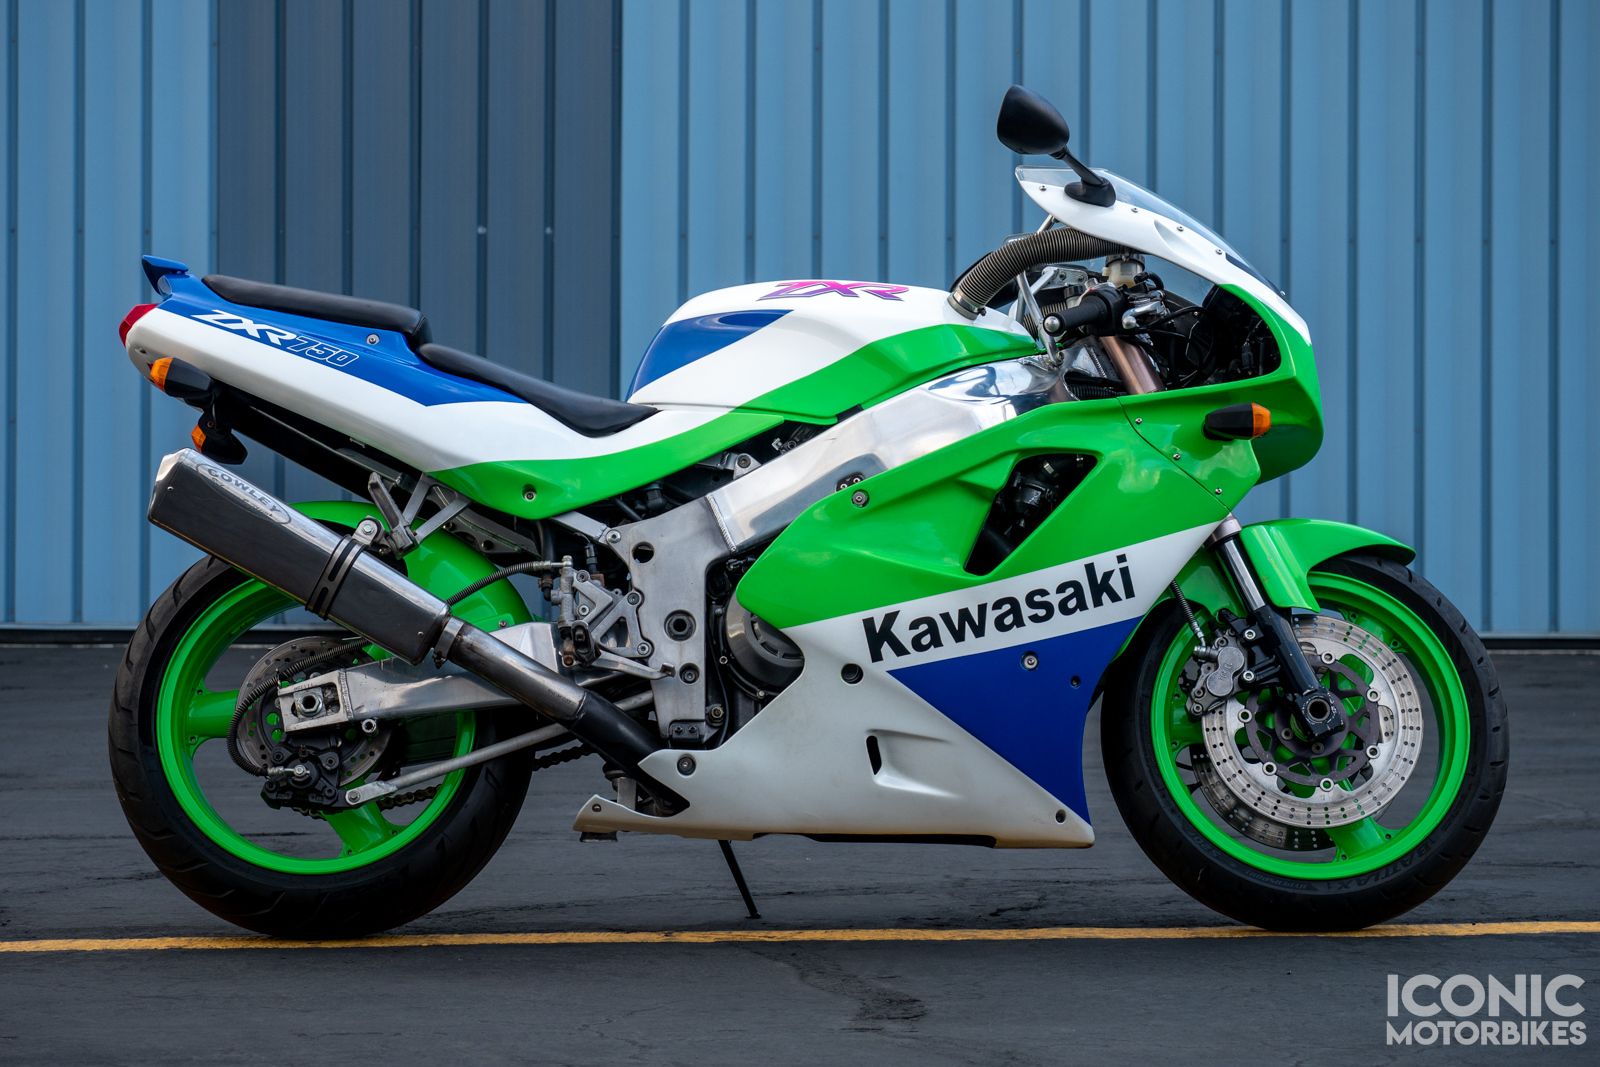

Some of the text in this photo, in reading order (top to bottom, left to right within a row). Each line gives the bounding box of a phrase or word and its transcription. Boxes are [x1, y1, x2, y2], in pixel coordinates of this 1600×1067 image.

[757, 281, 909, 301] ZXR
[207, 468, 282, 513] COWLEY
[862, 553, 1136, 663] Kawasaki
